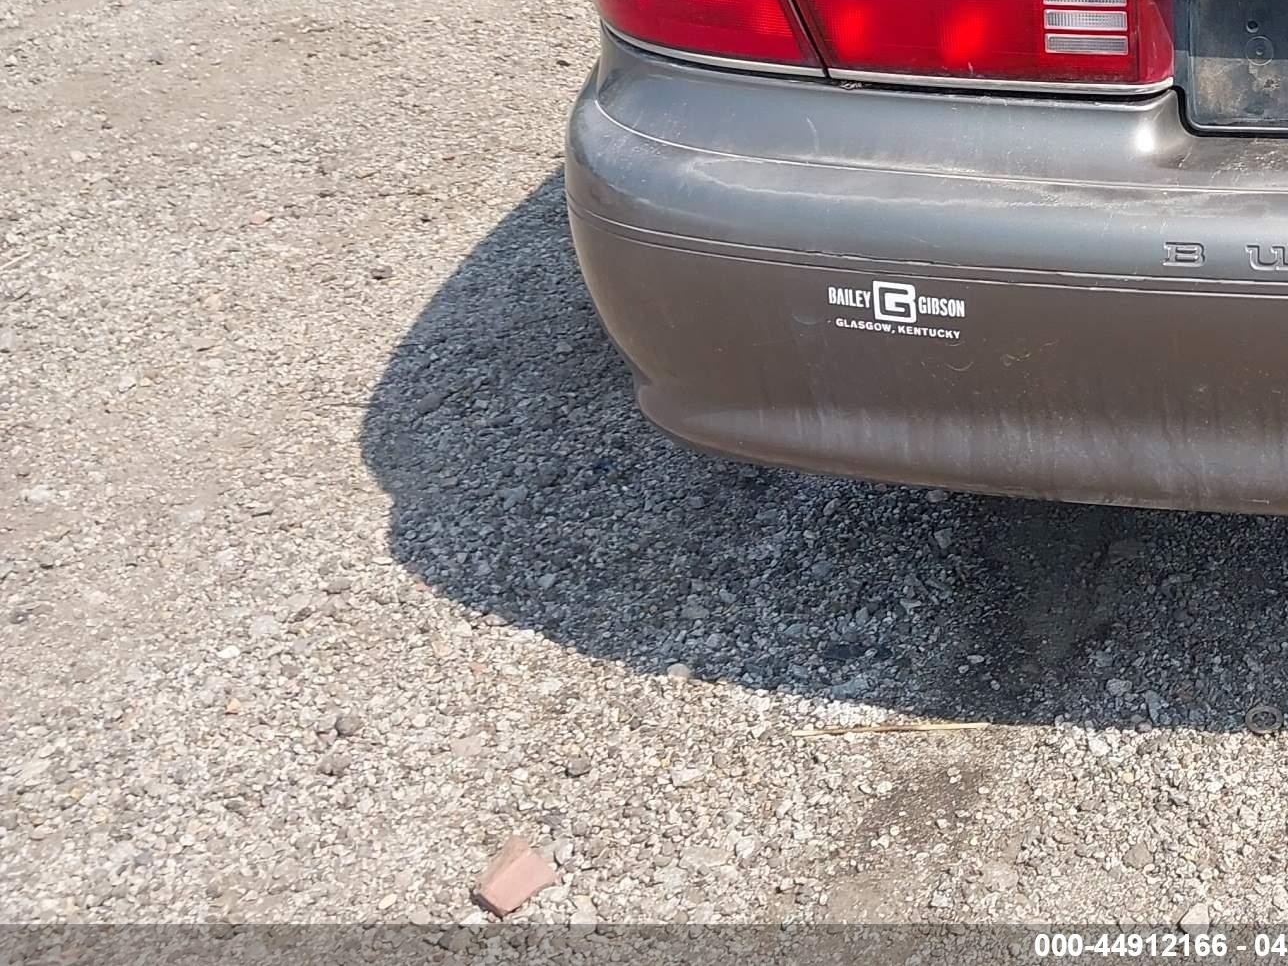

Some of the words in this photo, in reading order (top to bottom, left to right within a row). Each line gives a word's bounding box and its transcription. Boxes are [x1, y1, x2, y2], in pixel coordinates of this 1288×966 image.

[828, 286, 871, 309] BAILEY
[918, 296, 966, 318] GIBSON
[835, 318, 896, 334] GLASGOW,
[898, 325, 961, 339] KENTUCKY
